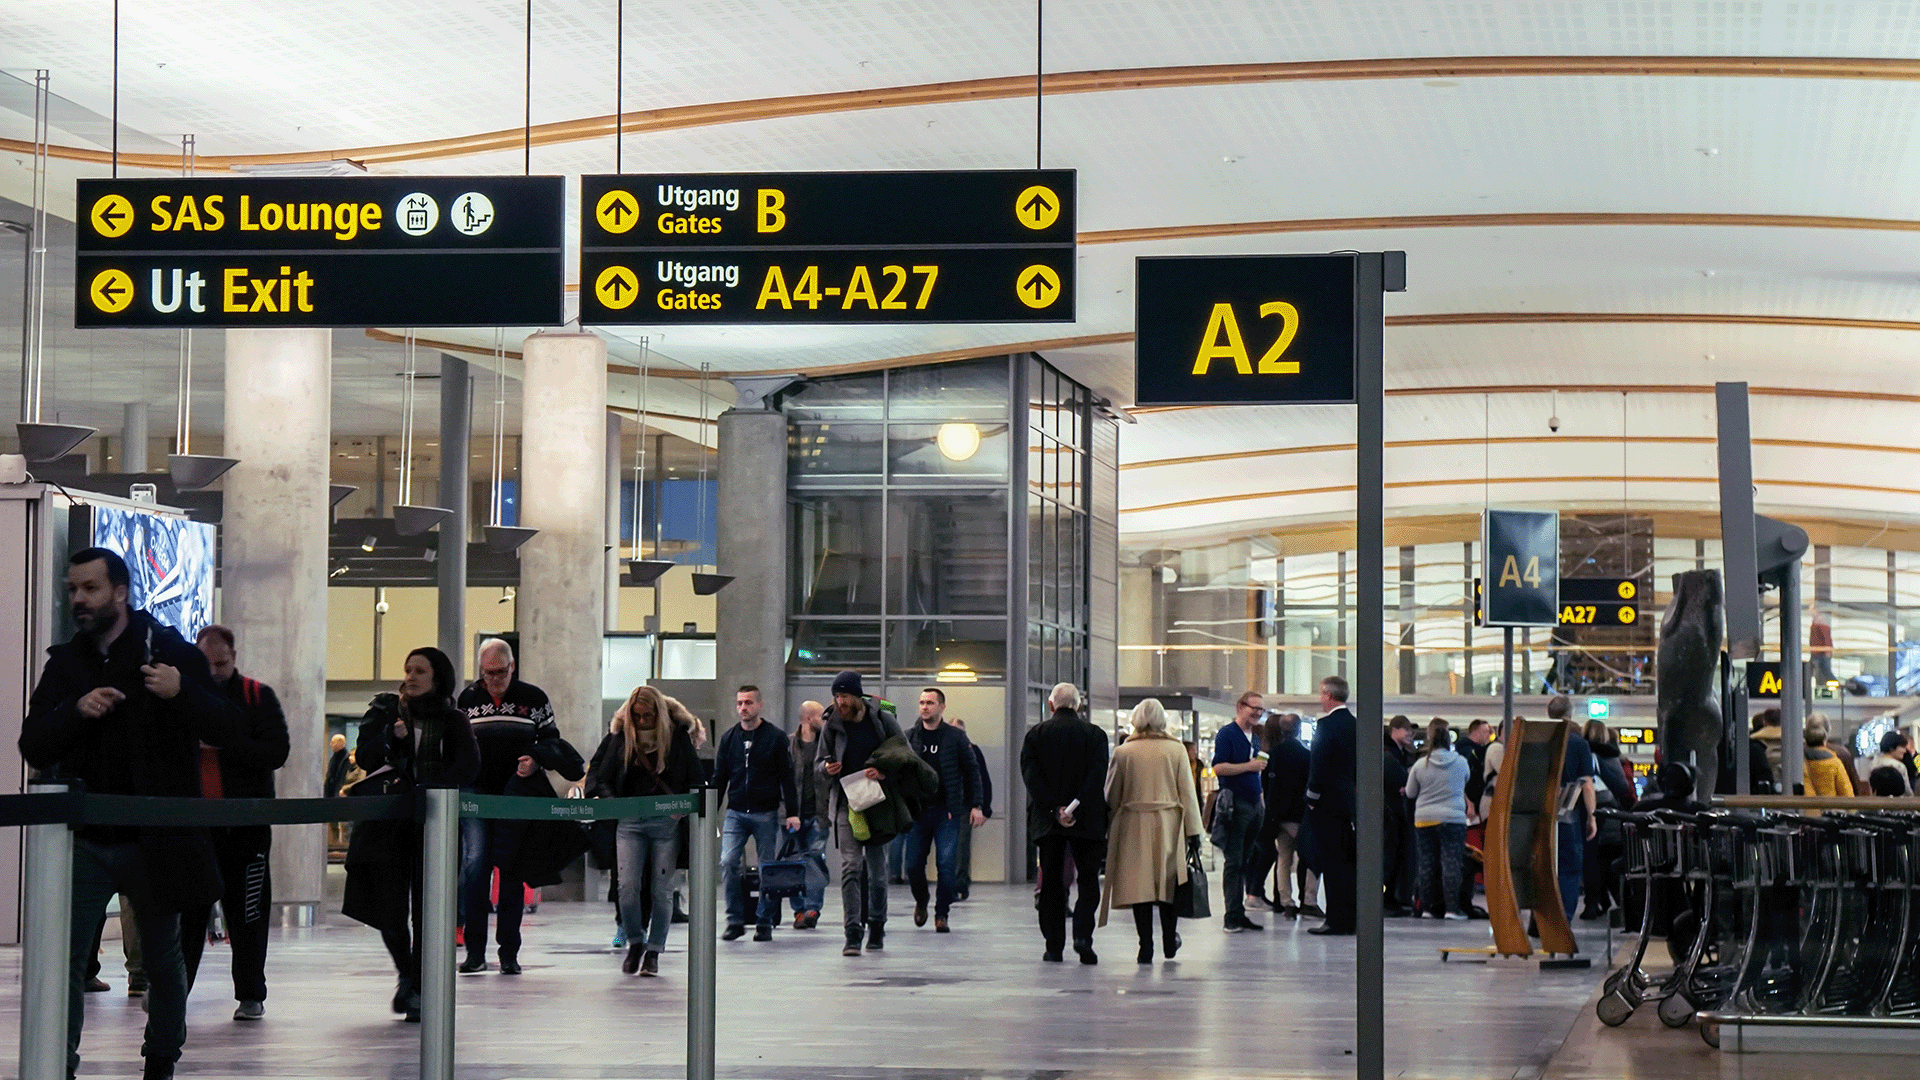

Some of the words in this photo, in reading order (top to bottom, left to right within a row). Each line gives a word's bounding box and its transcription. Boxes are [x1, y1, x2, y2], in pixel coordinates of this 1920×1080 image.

[657, 185, 740, 211] Utgang
[757, 188, 786, 233] B
[150, 194, 225, 232] SAS
[240, 194, 383, 241] Lounge
[657, 213, 722, 234] Gates
[151, 268, 206, 314] Ut
[223, 265, 314, 313] Exit
[657, 260, 740, 288] Utgang
[756, 265, 939, 310] A4-A27
[657, 288, 722, 310] Gates
[1191, 301, 1300, 375] A2
[1498, 554, 1542, 589] A4
[1759, 670, 1782, 694] A
[461, 801, 468, 812] No
[468, 801, 479, 815] Entry
